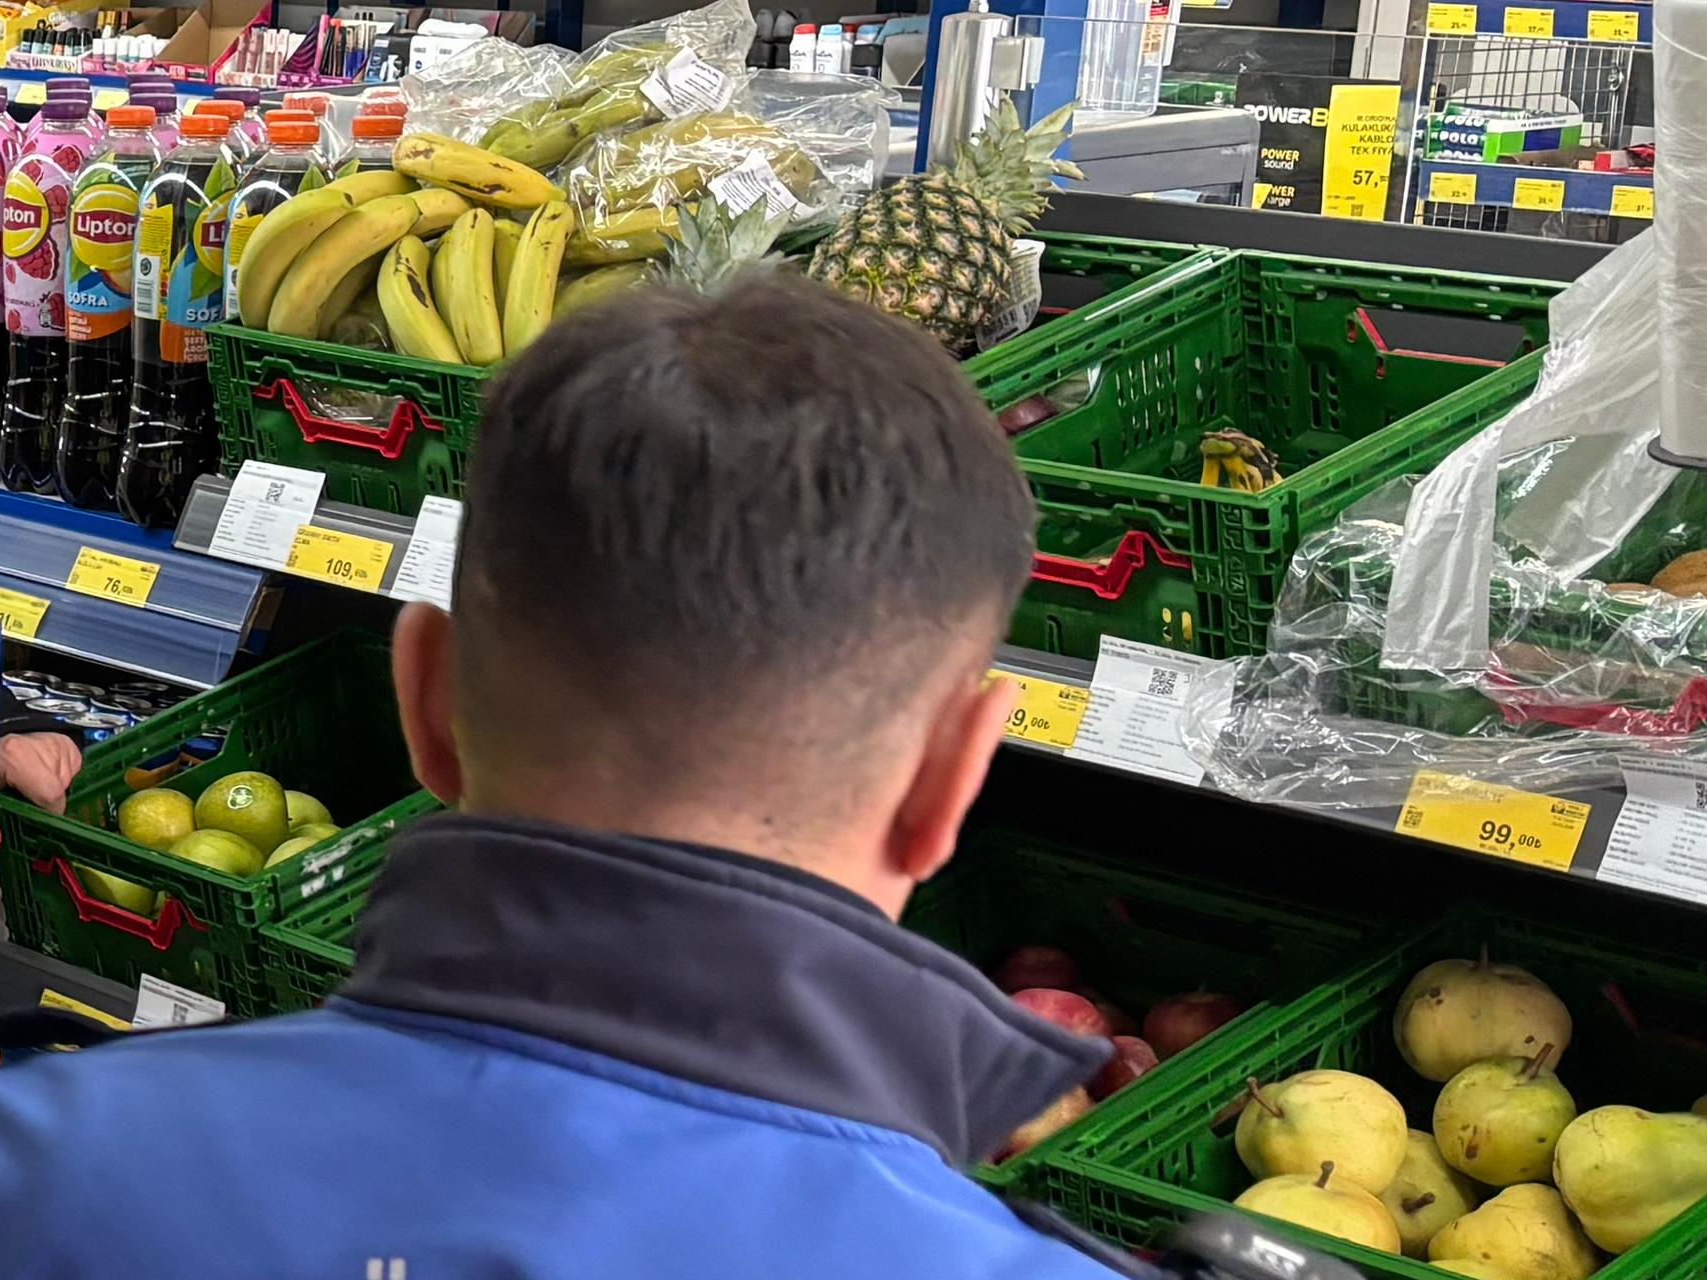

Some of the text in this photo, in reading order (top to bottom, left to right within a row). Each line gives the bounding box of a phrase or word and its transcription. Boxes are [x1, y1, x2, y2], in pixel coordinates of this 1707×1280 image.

[1261, 148, 1300, 161] POWER
[1264, 159, 1294, 170] sound
[1271, 185, 1296, 197] WER
[1267, 196, 1291, 207] arge
[3, 206, 35, 224] pton
[67, 291, 108, 308] SOFRA
[187, 308, 223, 321] SOF
